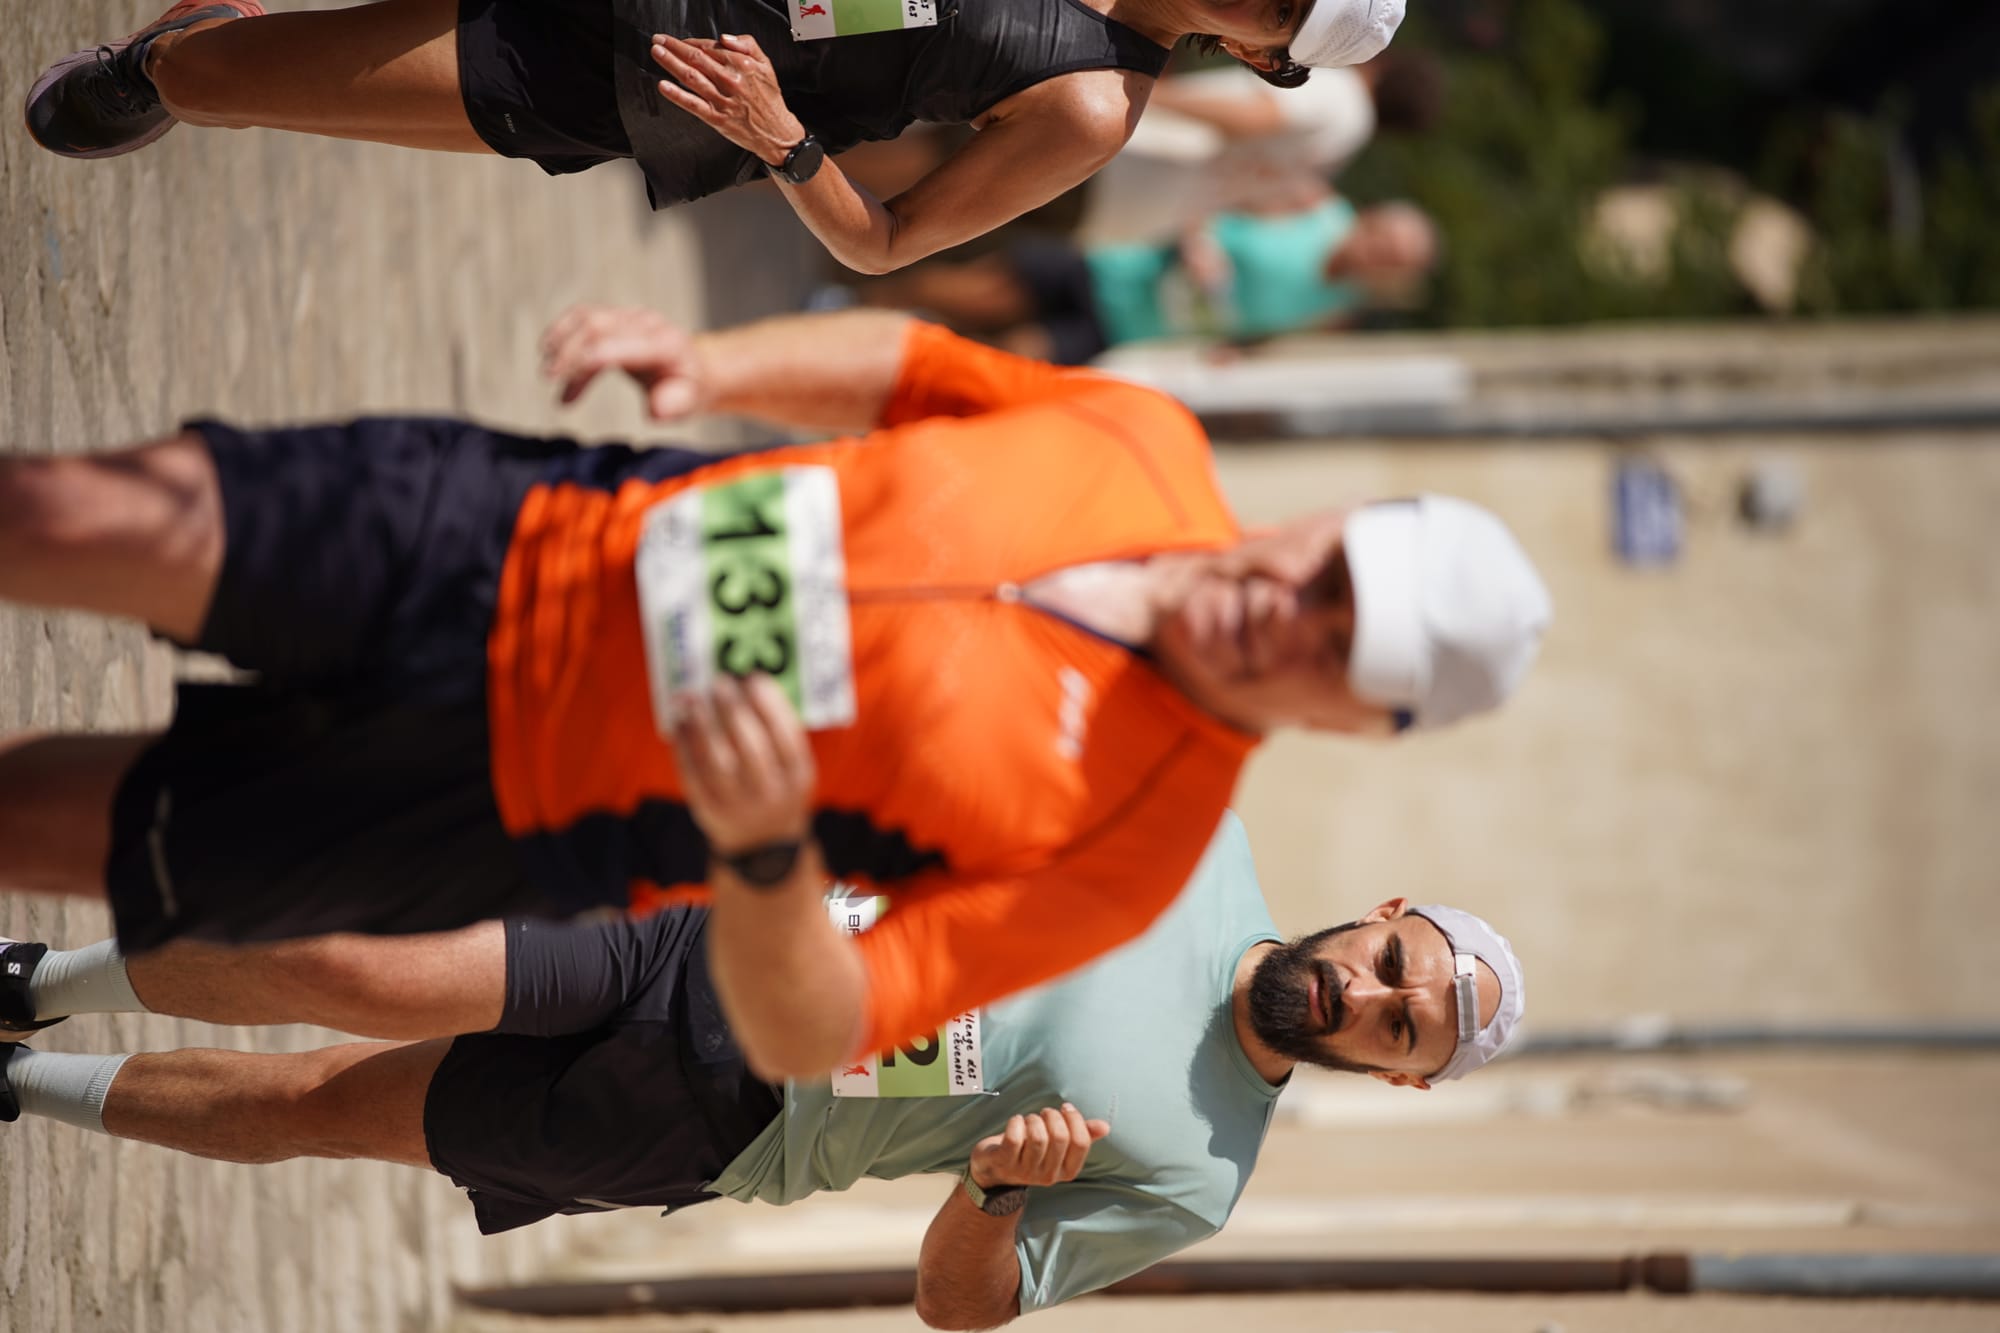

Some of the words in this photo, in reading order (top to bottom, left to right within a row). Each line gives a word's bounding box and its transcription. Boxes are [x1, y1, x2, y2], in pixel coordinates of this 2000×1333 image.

[704, 500, 789, 680] 133
[7, 962, 21, 975] S
[882, 1027, 940, 1068] 2
[952, 1031, 965, 1087] cévenoles
[967, 1058, 977, 1079] des
